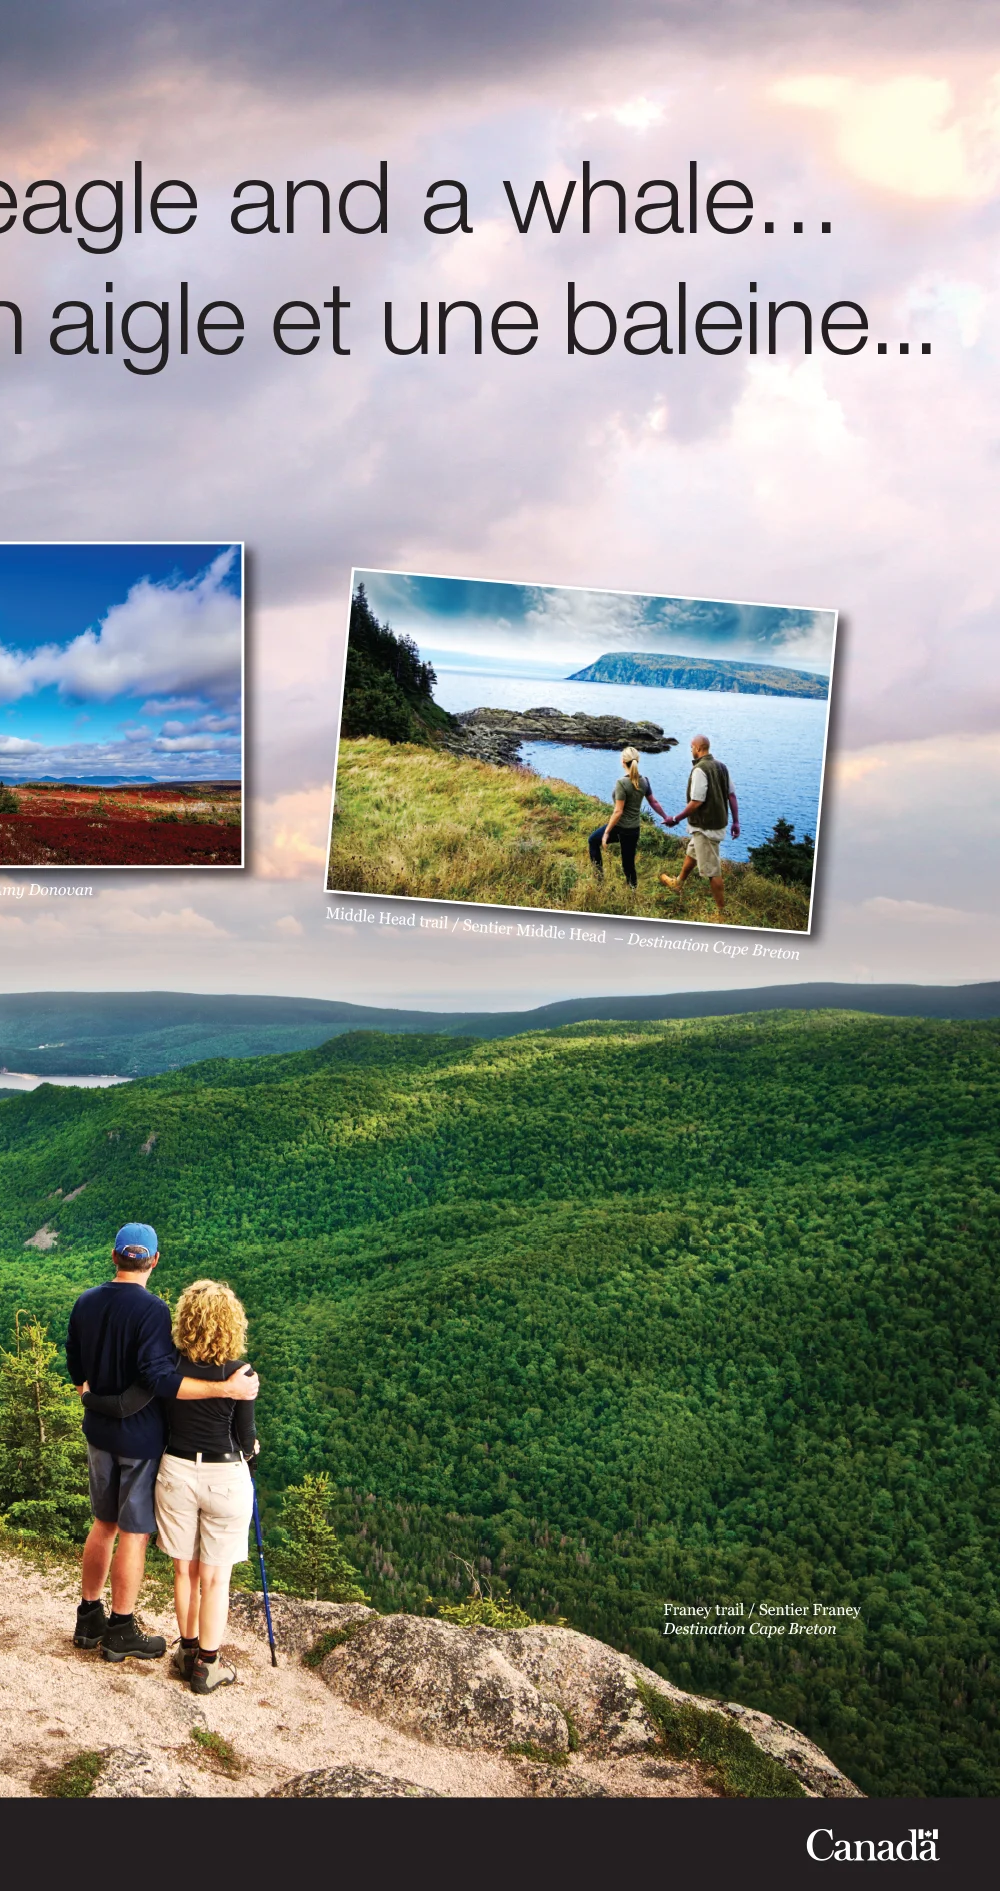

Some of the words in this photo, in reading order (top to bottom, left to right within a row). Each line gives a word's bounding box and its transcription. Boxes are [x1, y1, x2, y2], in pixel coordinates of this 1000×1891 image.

[230, 160, 388, 235] and
[423, 179, 474, 235] a
[49, 281, 245, 376] aigle
[273, 285, 351, 356] et
[384, 300, 539, 356] une
[27, 883, 94, 897] Donovan
[325, 906, 376, 924] Middle
[378, 911, 416, 927] Head
[419, 915, 449, 930] trail
[462, 918, 514, 936] Sentier
[515, 923, 566, 940] Middle
[568, 927, 607, 944] Head
[626, 932, 710, 953] Destination
[712, 940, 749, 959] Cape
[751, 943, 800, 961] Breton
[663, 1603, 712, 1619] Franey
[715, 1602, 744, 1616] trail
[759, 1602, 809, 1616] Sentier
[812, 1603, 861, 1619] Franey
[663, 1621, 745, 1635] Destination
[749, 1622, 785, 1638] Cape
[788, 1622, 836, 1635] Breton
[806, 1828, 941, 1862] Canada
